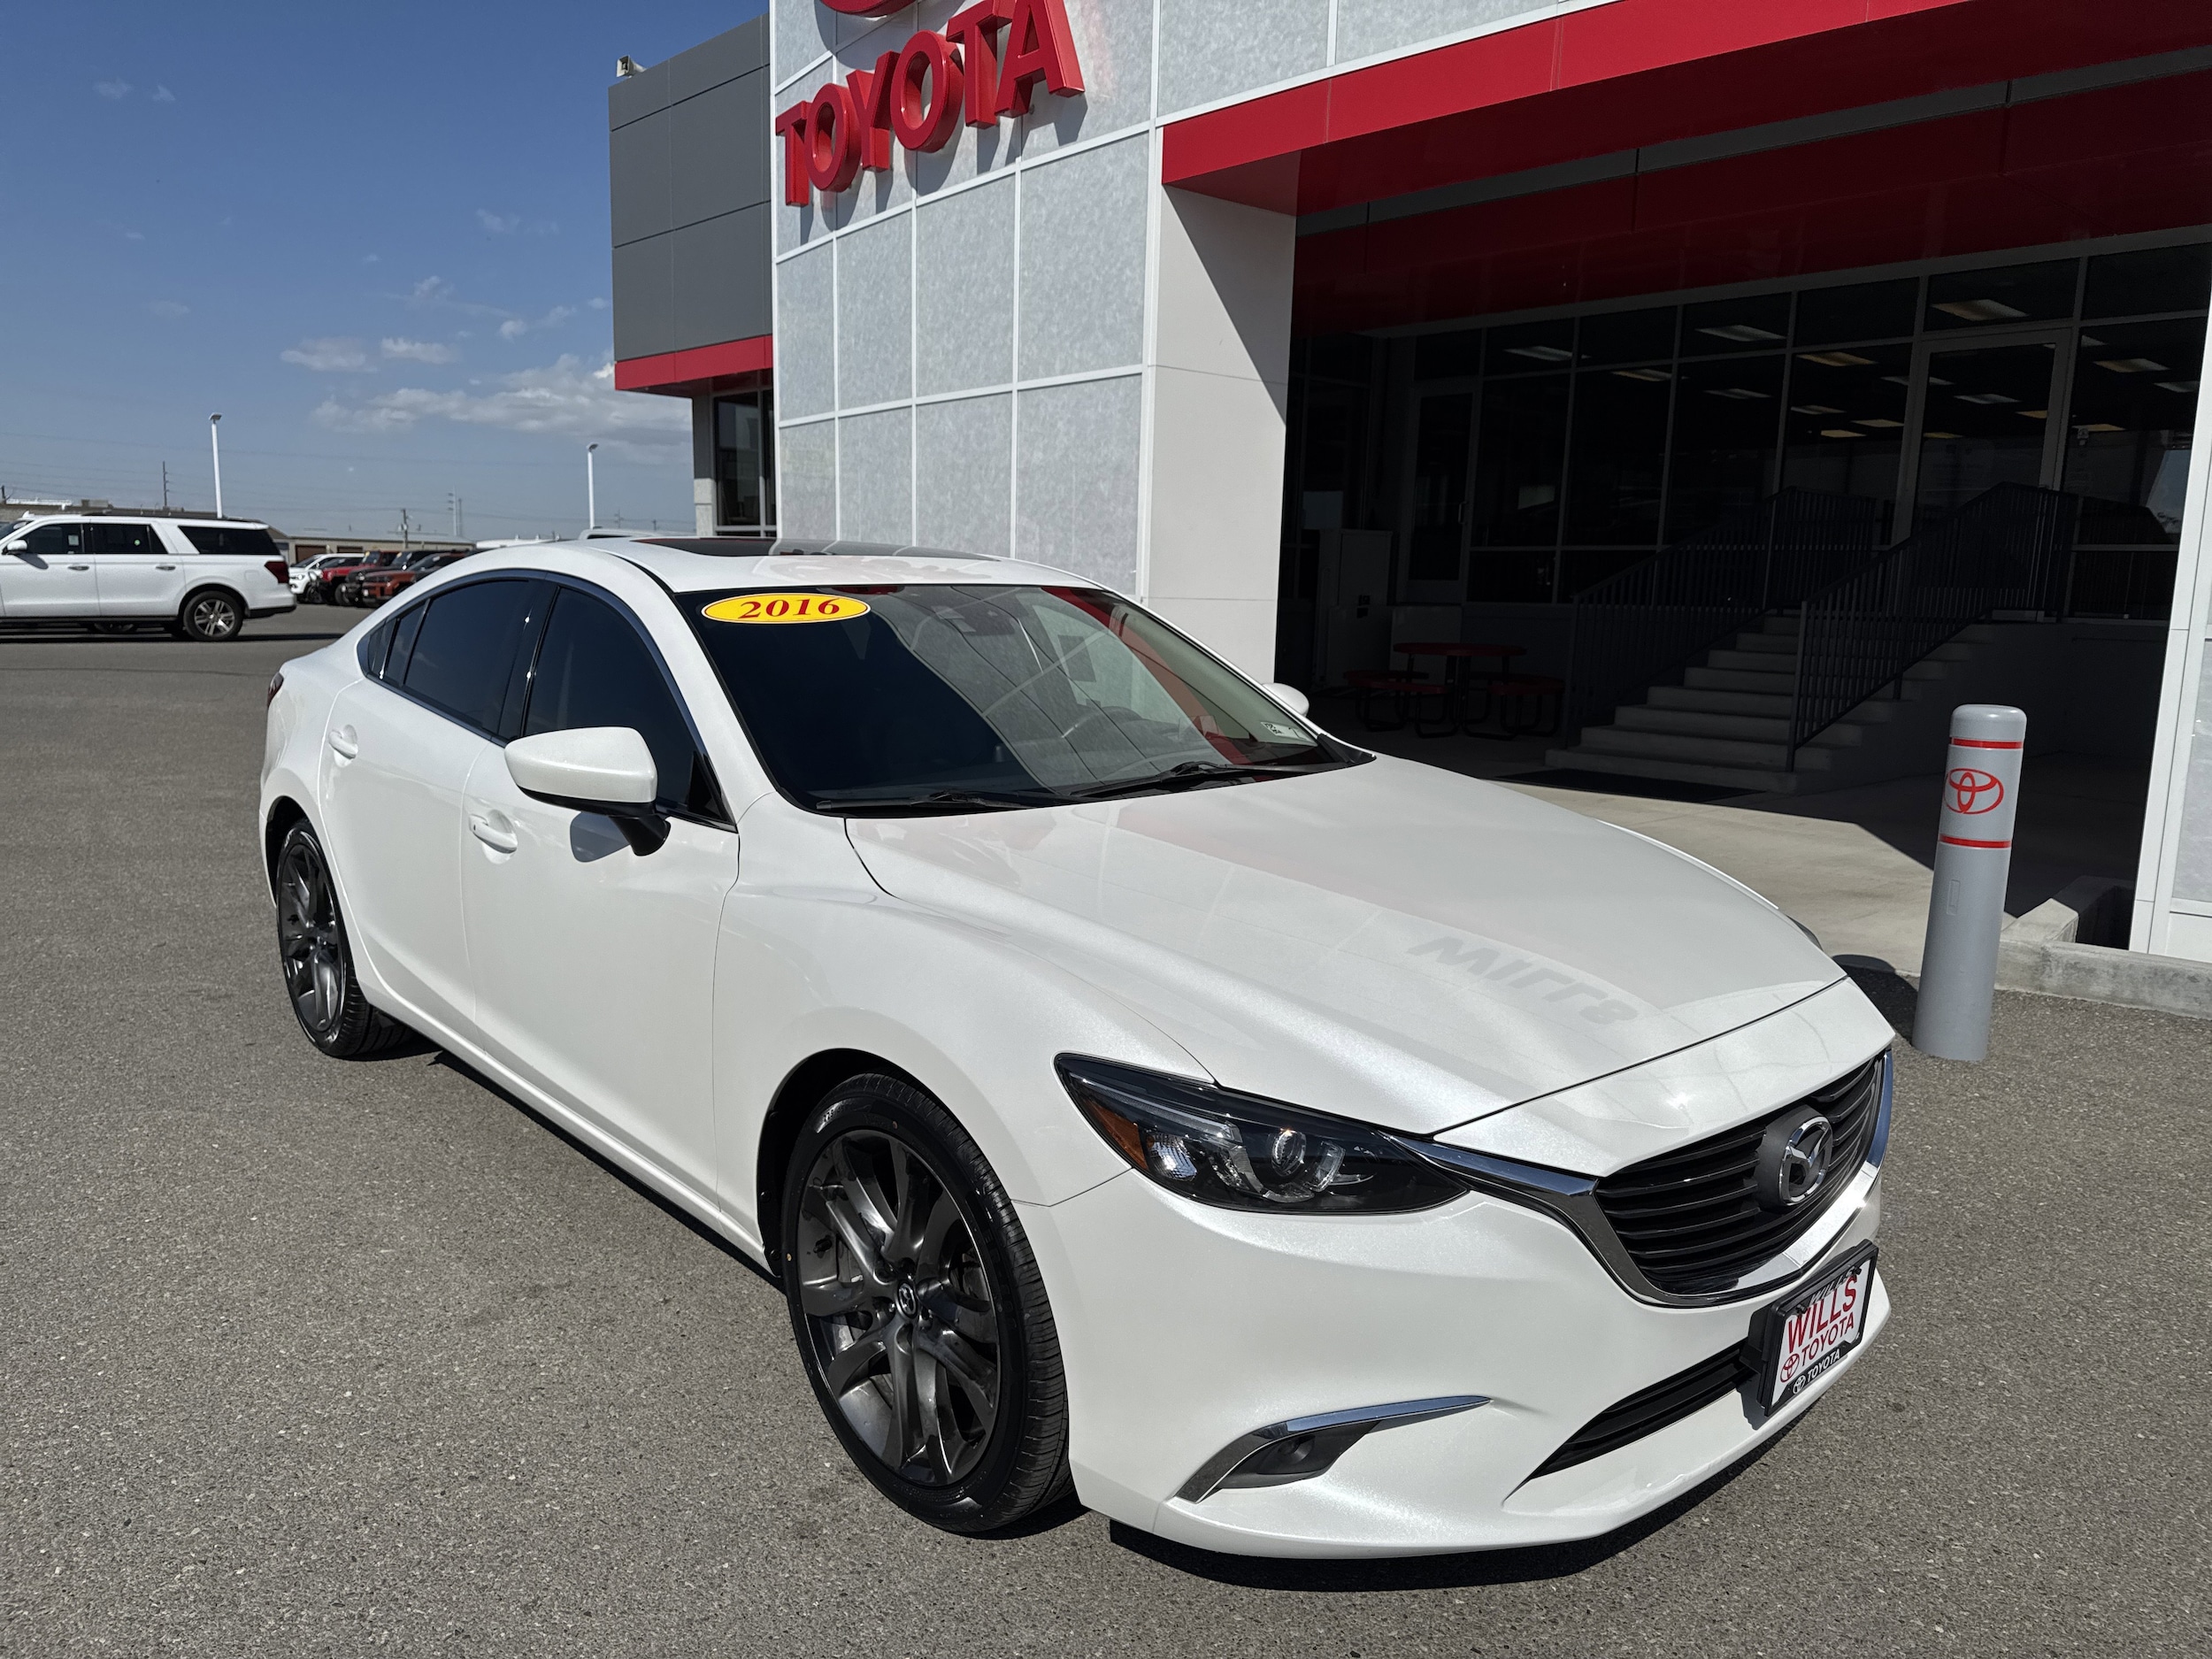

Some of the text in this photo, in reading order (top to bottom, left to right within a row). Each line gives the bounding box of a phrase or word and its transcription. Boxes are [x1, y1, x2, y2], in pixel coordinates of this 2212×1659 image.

[775, 0, 1085, 206] TOYOTA
[738, 597, 841, 619] 2016
[1788, 1274, 1857, 1354] WILLS
[1801, 1313, 1855, 1366] TOYOTA
[1807, 1348, 1840, 1383] TOYOTA
